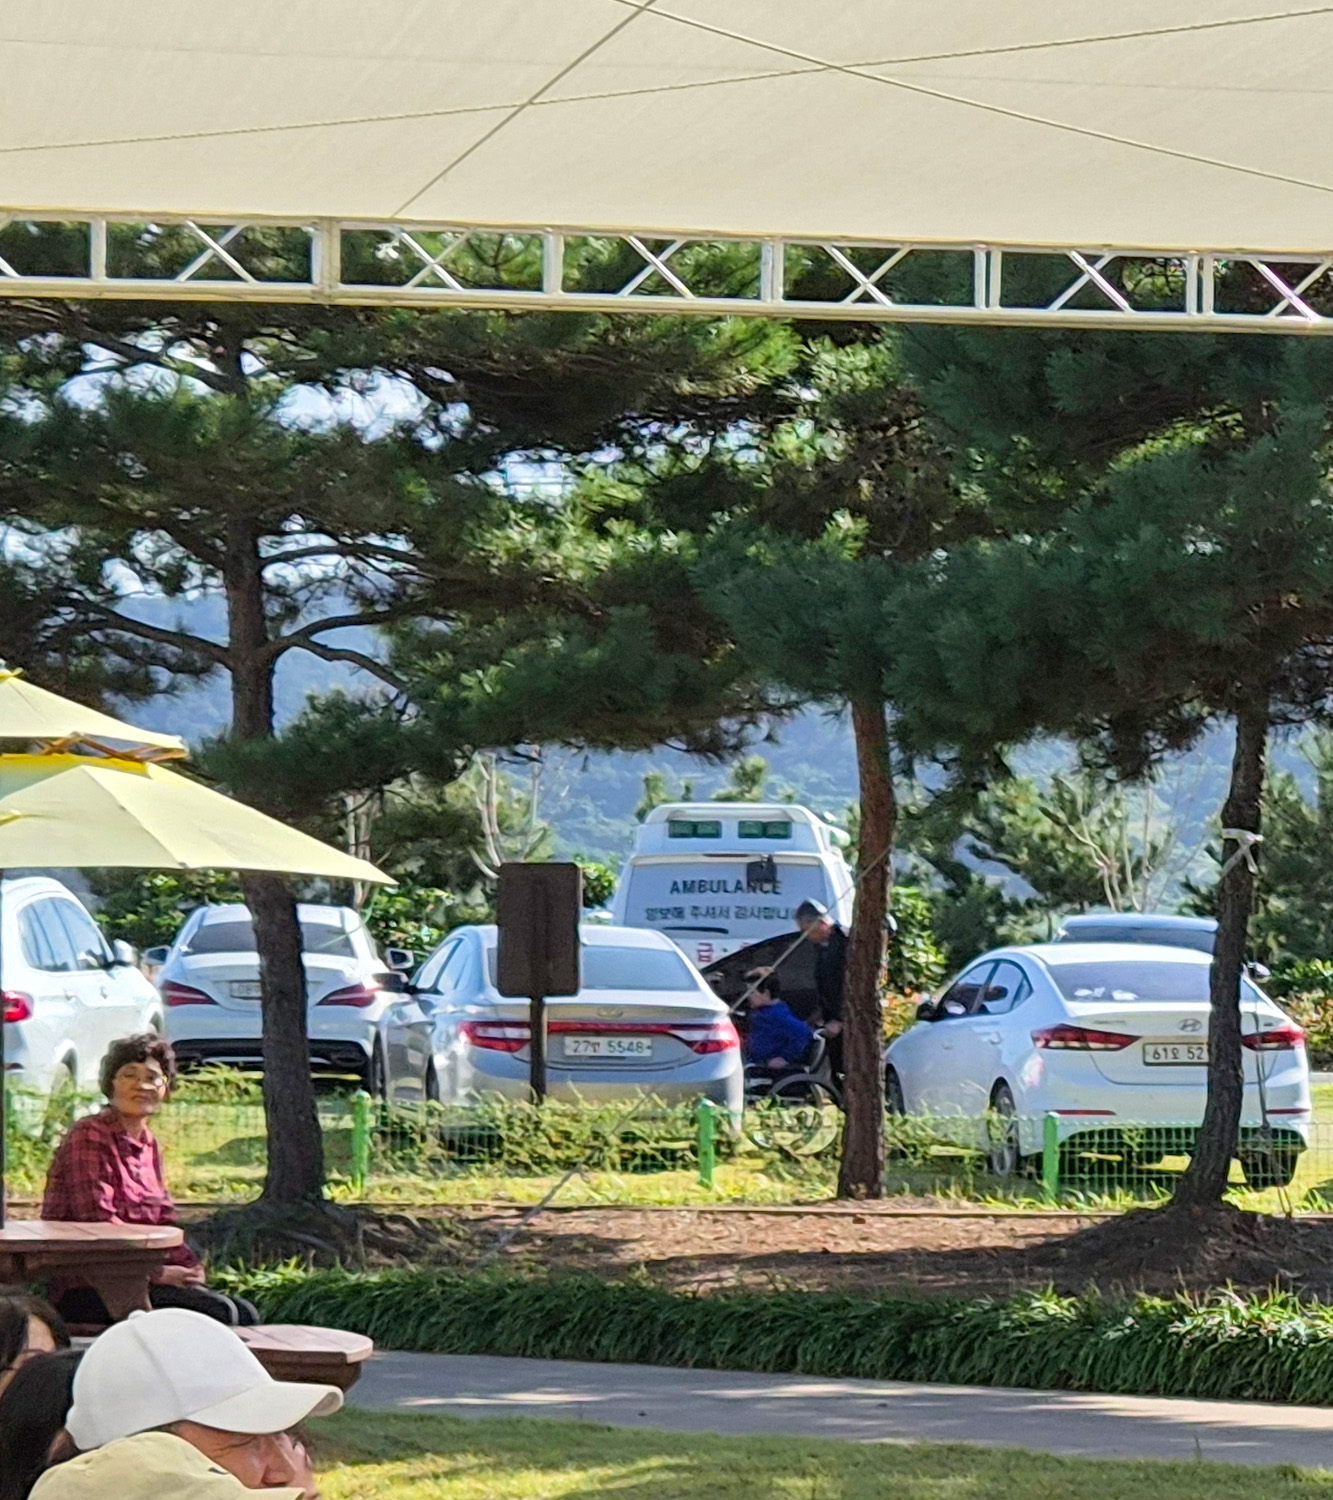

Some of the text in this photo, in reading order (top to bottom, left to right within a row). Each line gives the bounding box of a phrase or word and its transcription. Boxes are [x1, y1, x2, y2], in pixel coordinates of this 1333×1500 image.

[670, 880, 782, 895] AMBULANCE
[690, 904, 730, 920] 주셔서
[734, 905, 796, 920] 감사합니
